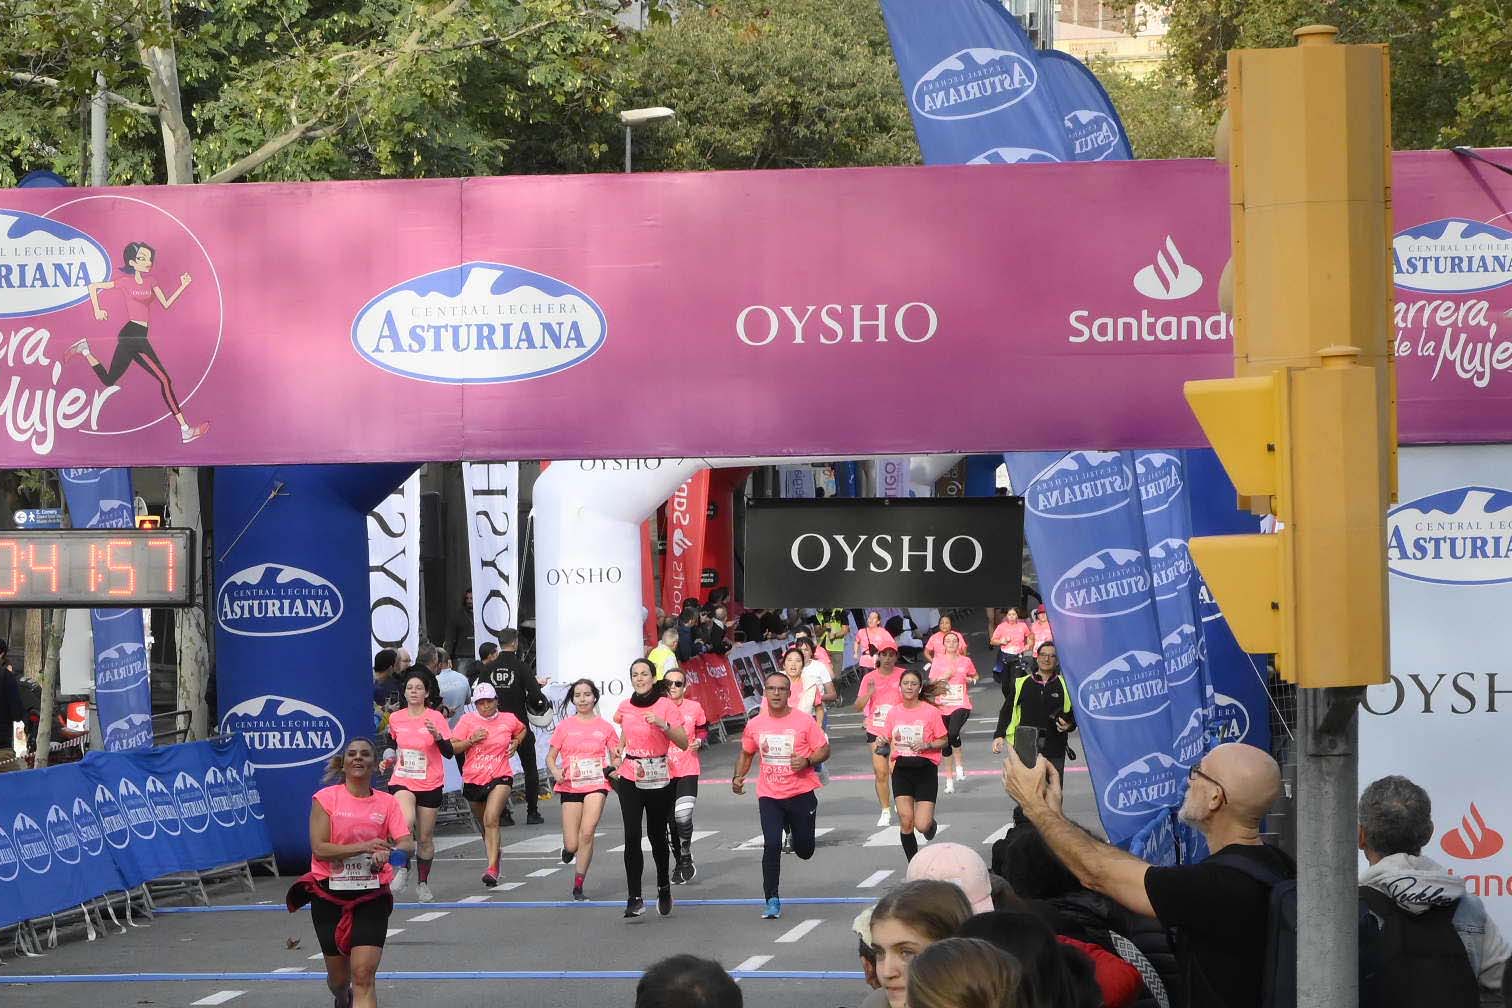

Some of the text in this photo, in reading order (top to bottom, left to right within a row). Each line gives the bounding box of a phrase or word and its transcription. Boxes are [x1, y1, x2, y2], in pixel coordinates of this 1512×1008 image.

[14, 245, 86, 257] LECHERA
[1464, 242, 1512, 251] LECHER
[410, 302, 579, 317] CENTRAL LECHERA
[1392, 299, 1490, 328] arrera
[371, 309, 587, 354] ASTURIANA
[736, 302, 938, 346] OYSHO
[1417, 322, 1512, 388] la Muje
[1415, 520, 1483, 532] CENTRAL
[790, 532, 983, 574] OYSHO
[546, 566, 622, 586] OYSHO
[234, 588, 329, 597] CENTRAL LECHERA
[221, 593, 334, 620] ASTURIANA
[496, 672, 509, 681] BP
[235, 719, 330, 728] CENTRAL LECHERA
